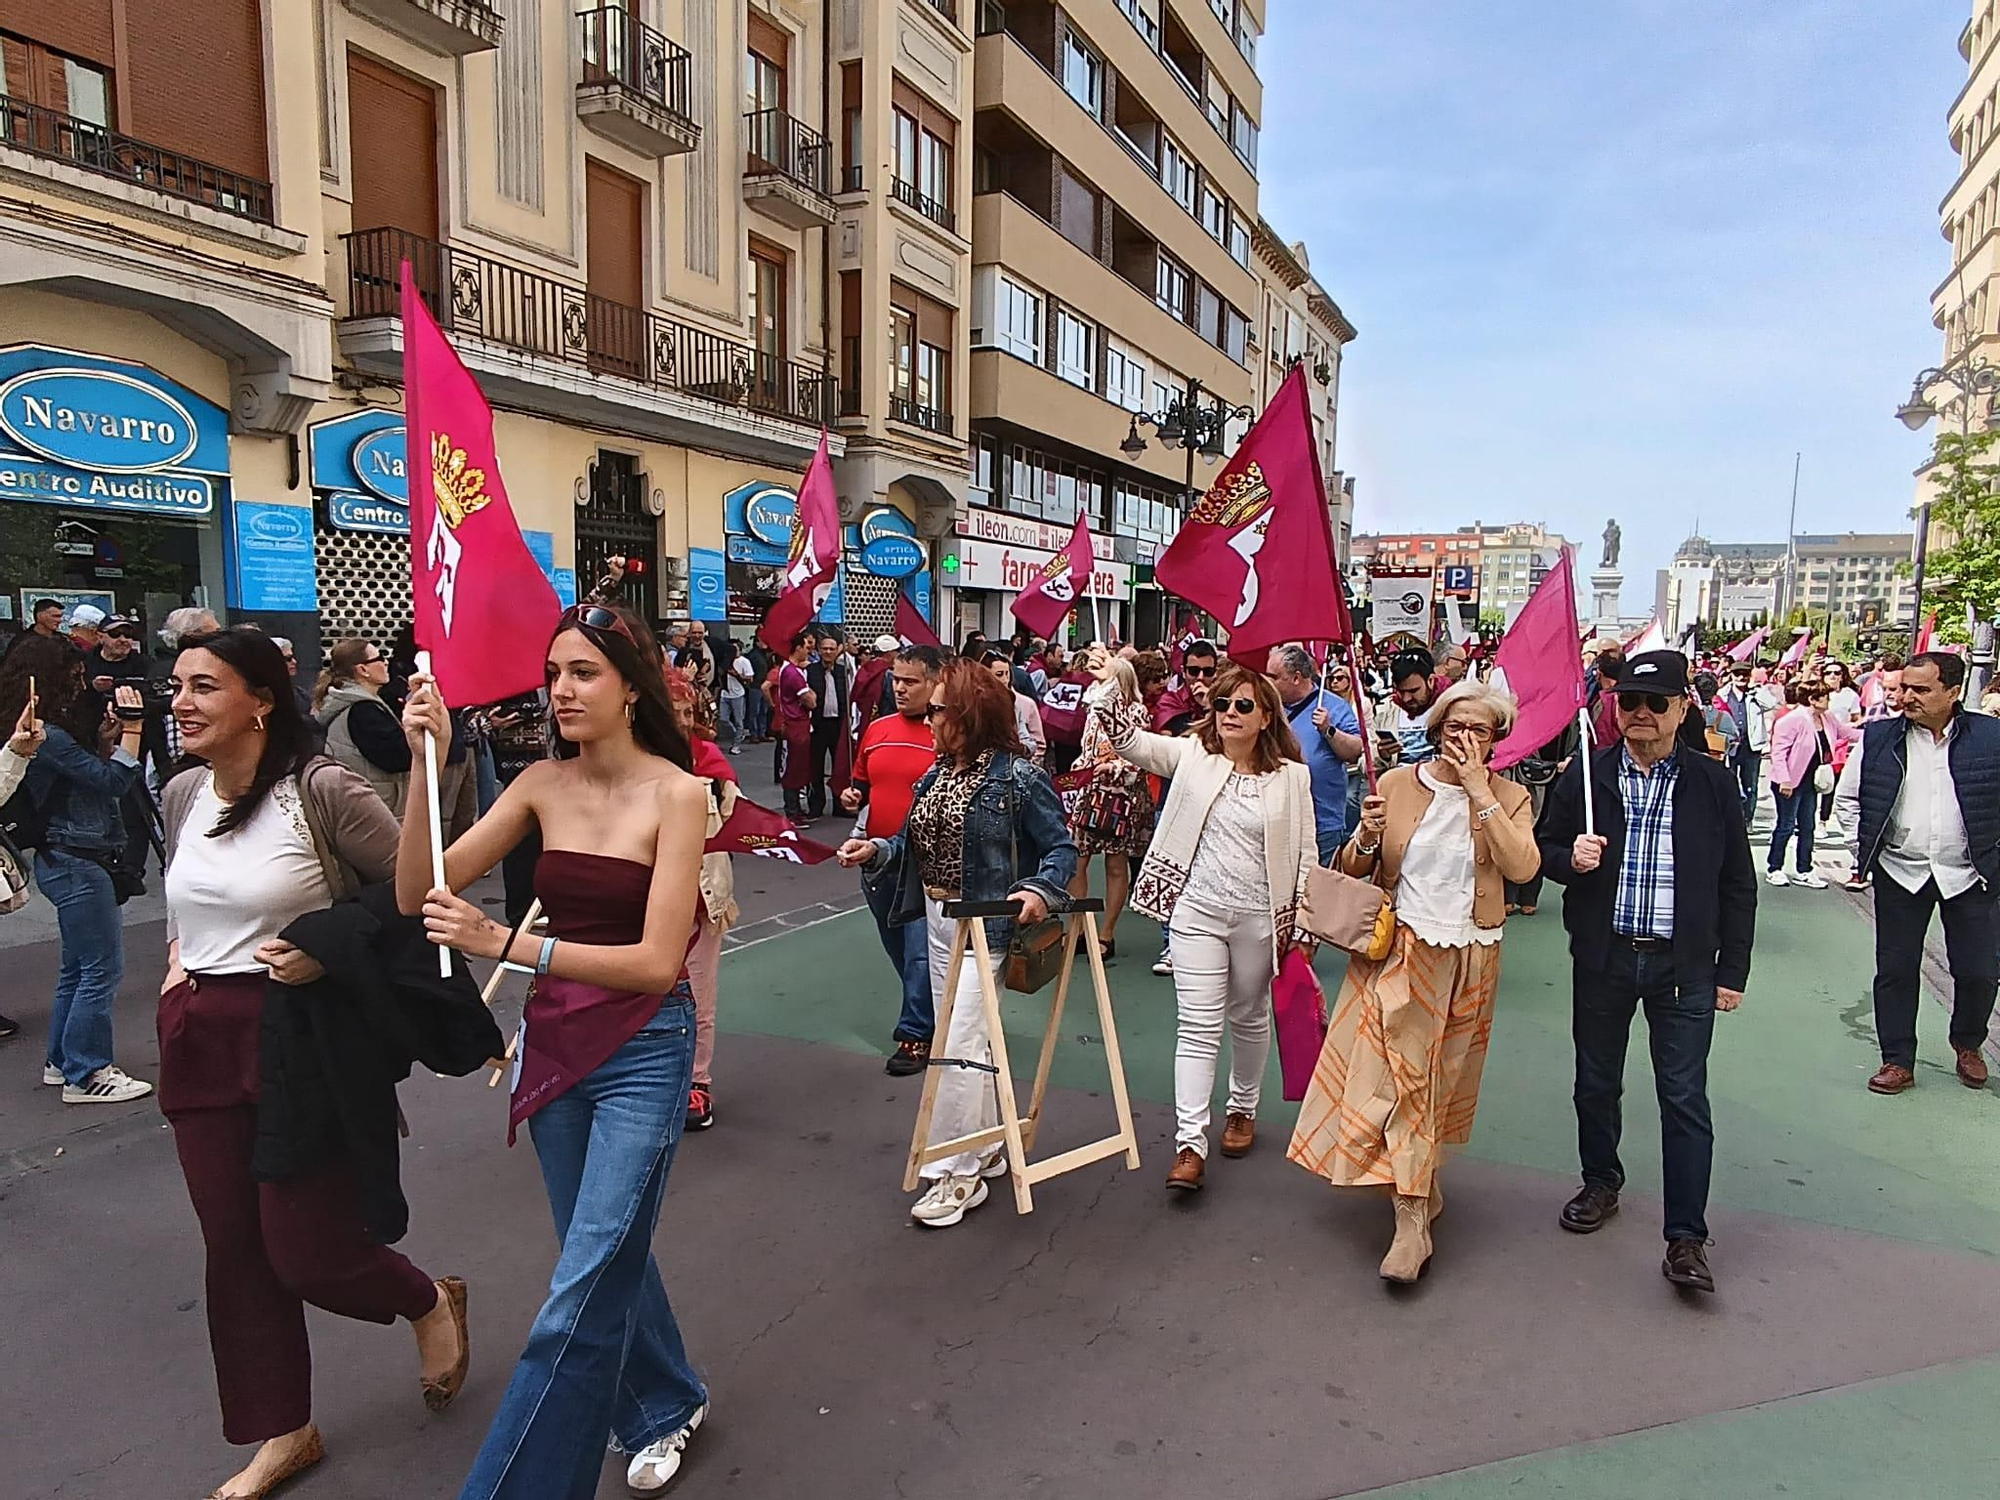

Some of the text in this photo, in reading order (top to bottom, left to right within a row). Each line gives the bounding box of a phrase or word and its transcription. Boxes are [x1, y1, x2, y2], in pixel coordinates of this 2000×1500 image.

[22, 395, 176, 444] Navarro
[0, 469, 203, 504] entro Auditivo
[340, 501, 404, 524] Centro
[867, 554, 916, 566] Navarro
[1451, 567, 1467, 588] P
